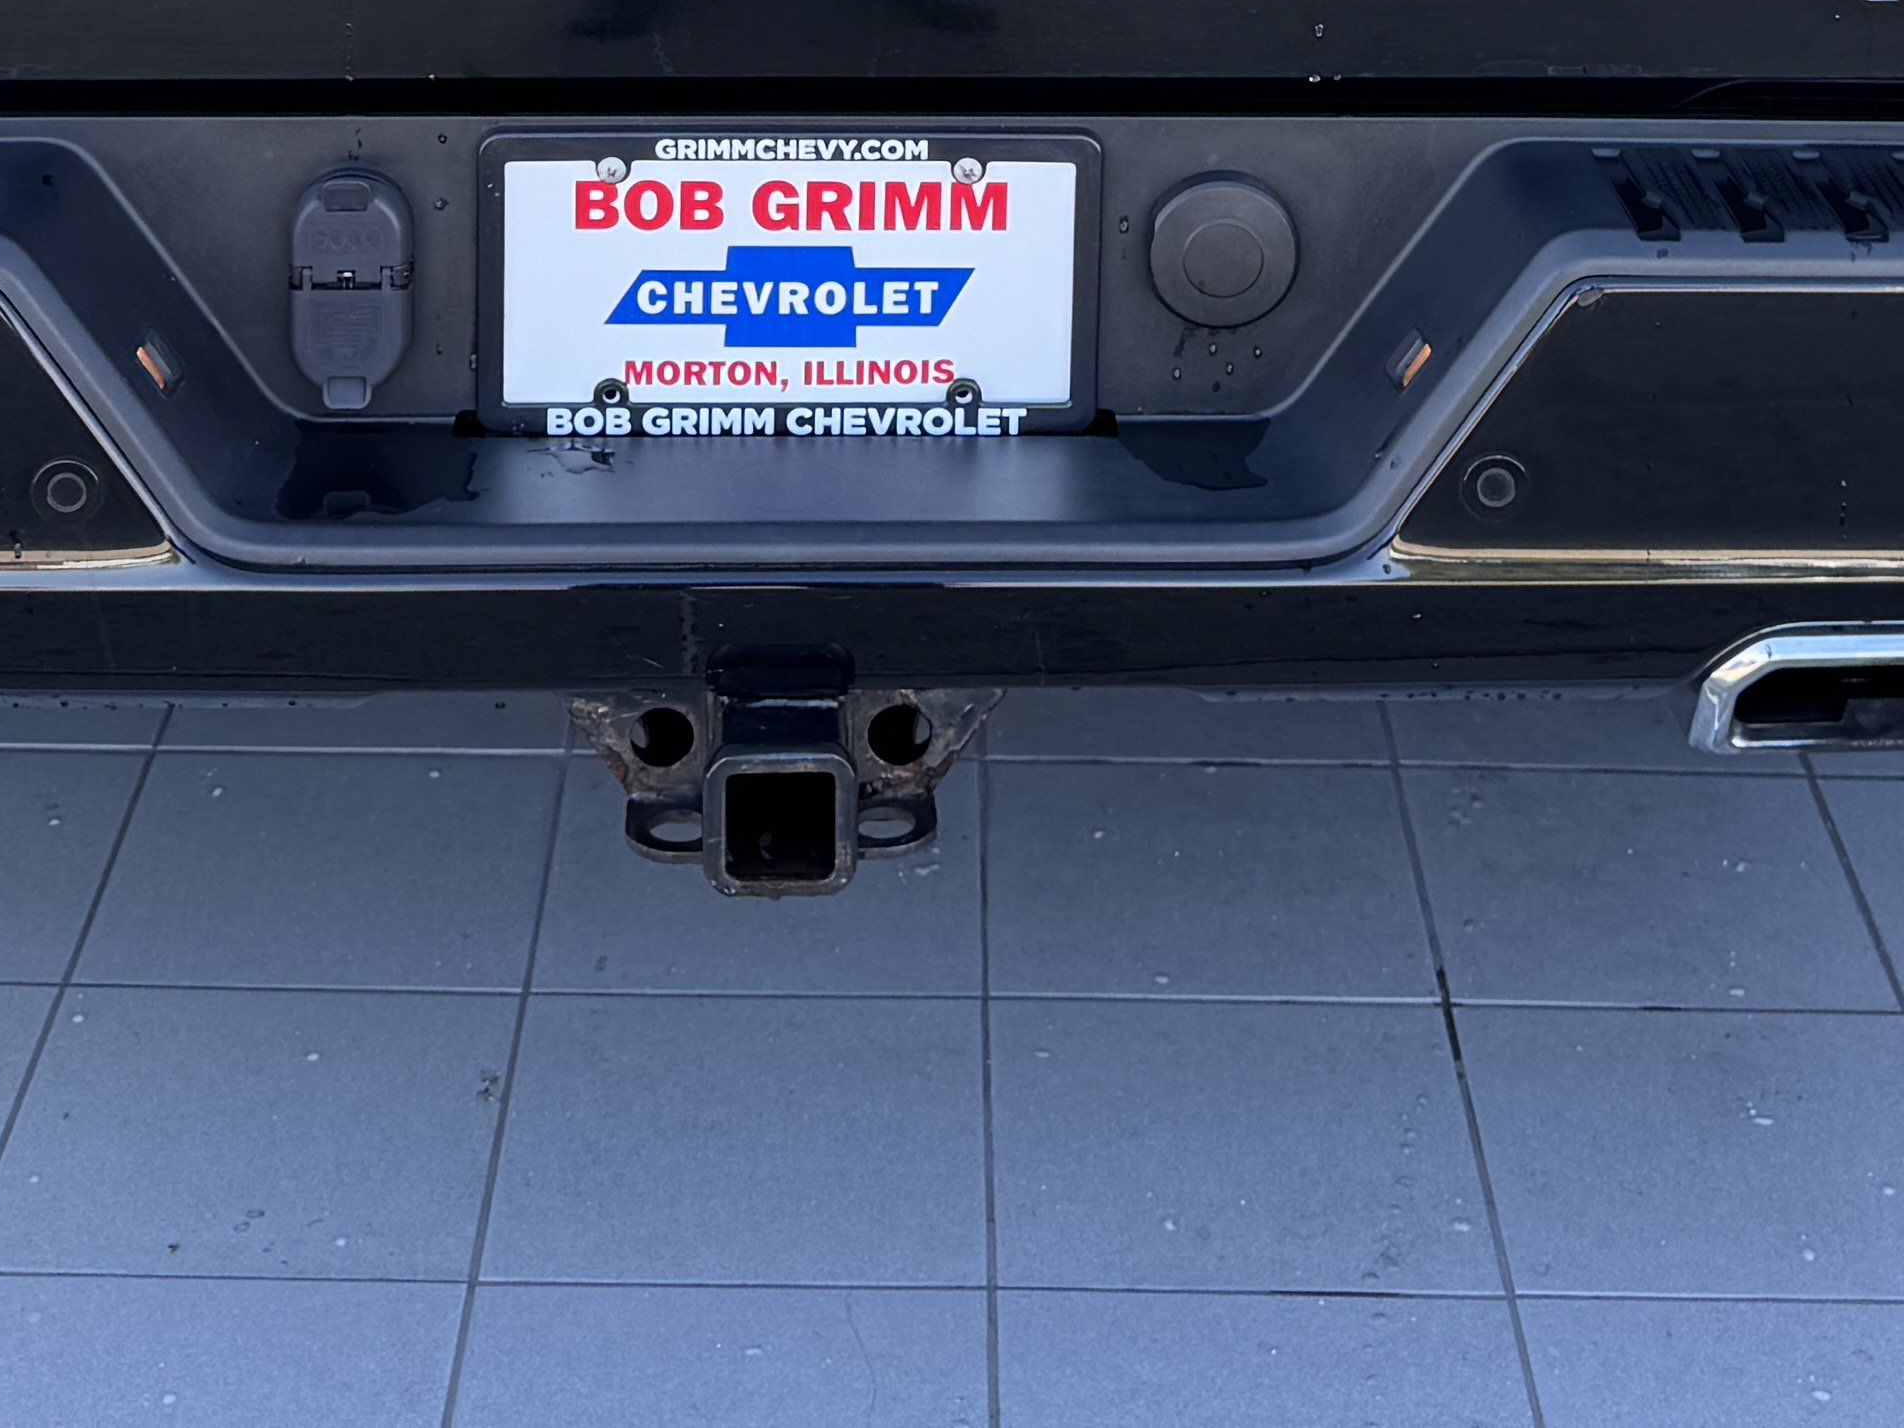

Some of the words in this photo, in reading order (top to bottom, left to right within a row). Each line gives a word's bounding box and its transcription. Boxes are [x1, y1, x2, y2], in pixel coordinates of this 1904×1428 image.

[654, 138, 930, 161] GRIMMCHEVY.COM
[574, 180, 725, 232] BOB
[751, 180, 1009, 232] GRIMM
[635, 280, 940, 316] CHEVROLET
[624, 360, 790, 392] MORTON,
[804, 359, 957, 384] ILLINOIS
[546, 407, 633, 436] BOB
[641, 407, 776, 436] GRIMM
[786, 407, 1028, 436] CHEVROLET
